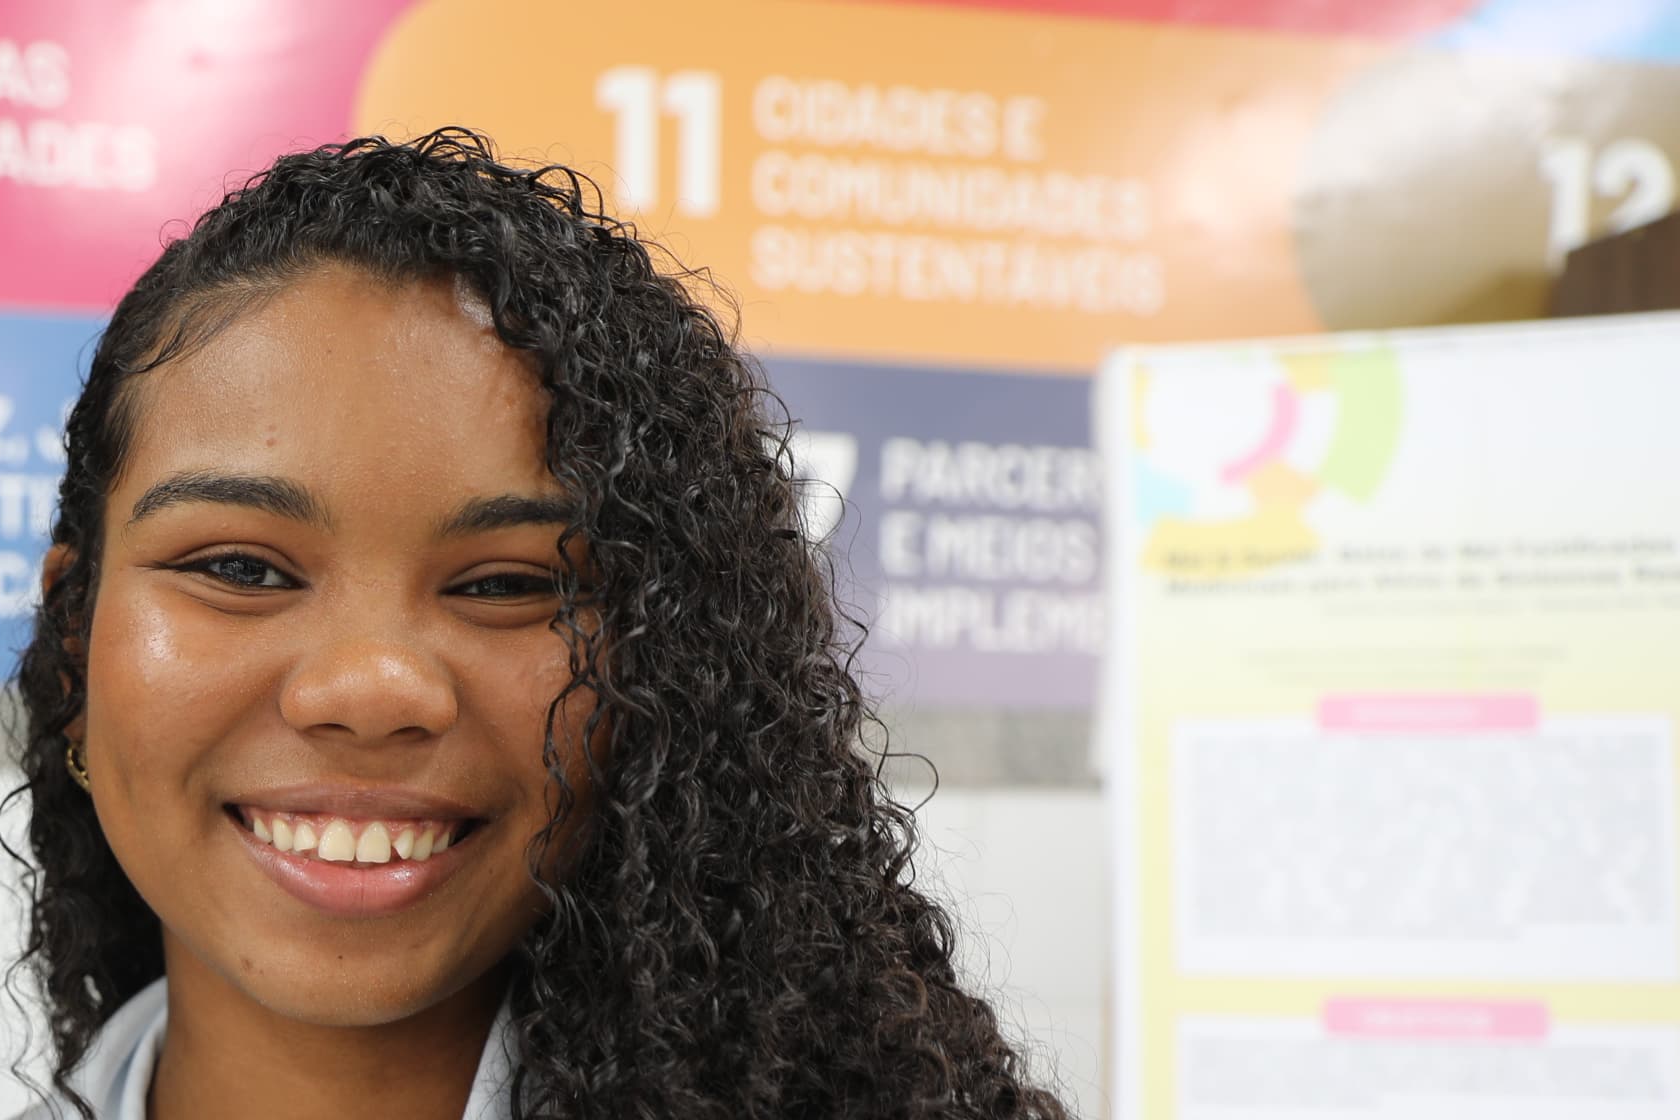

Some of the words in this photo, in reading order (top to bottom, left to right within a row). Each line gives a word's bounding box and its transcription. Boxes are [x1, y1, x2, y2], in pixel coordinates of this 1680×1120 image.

[596, 67, 722, 218] 11
[751, 76, 998, 158] CIDADES
[1003, 95, 1047, 162] E
[750, 150, 1152, 241] COMUNIDADES
[1537, 140, 1676, 274] 12
[880, 436, 1102, 512] PARCER
[878, 509, 922, 578] E
[924, 514, 1102, 585] MEIOS
